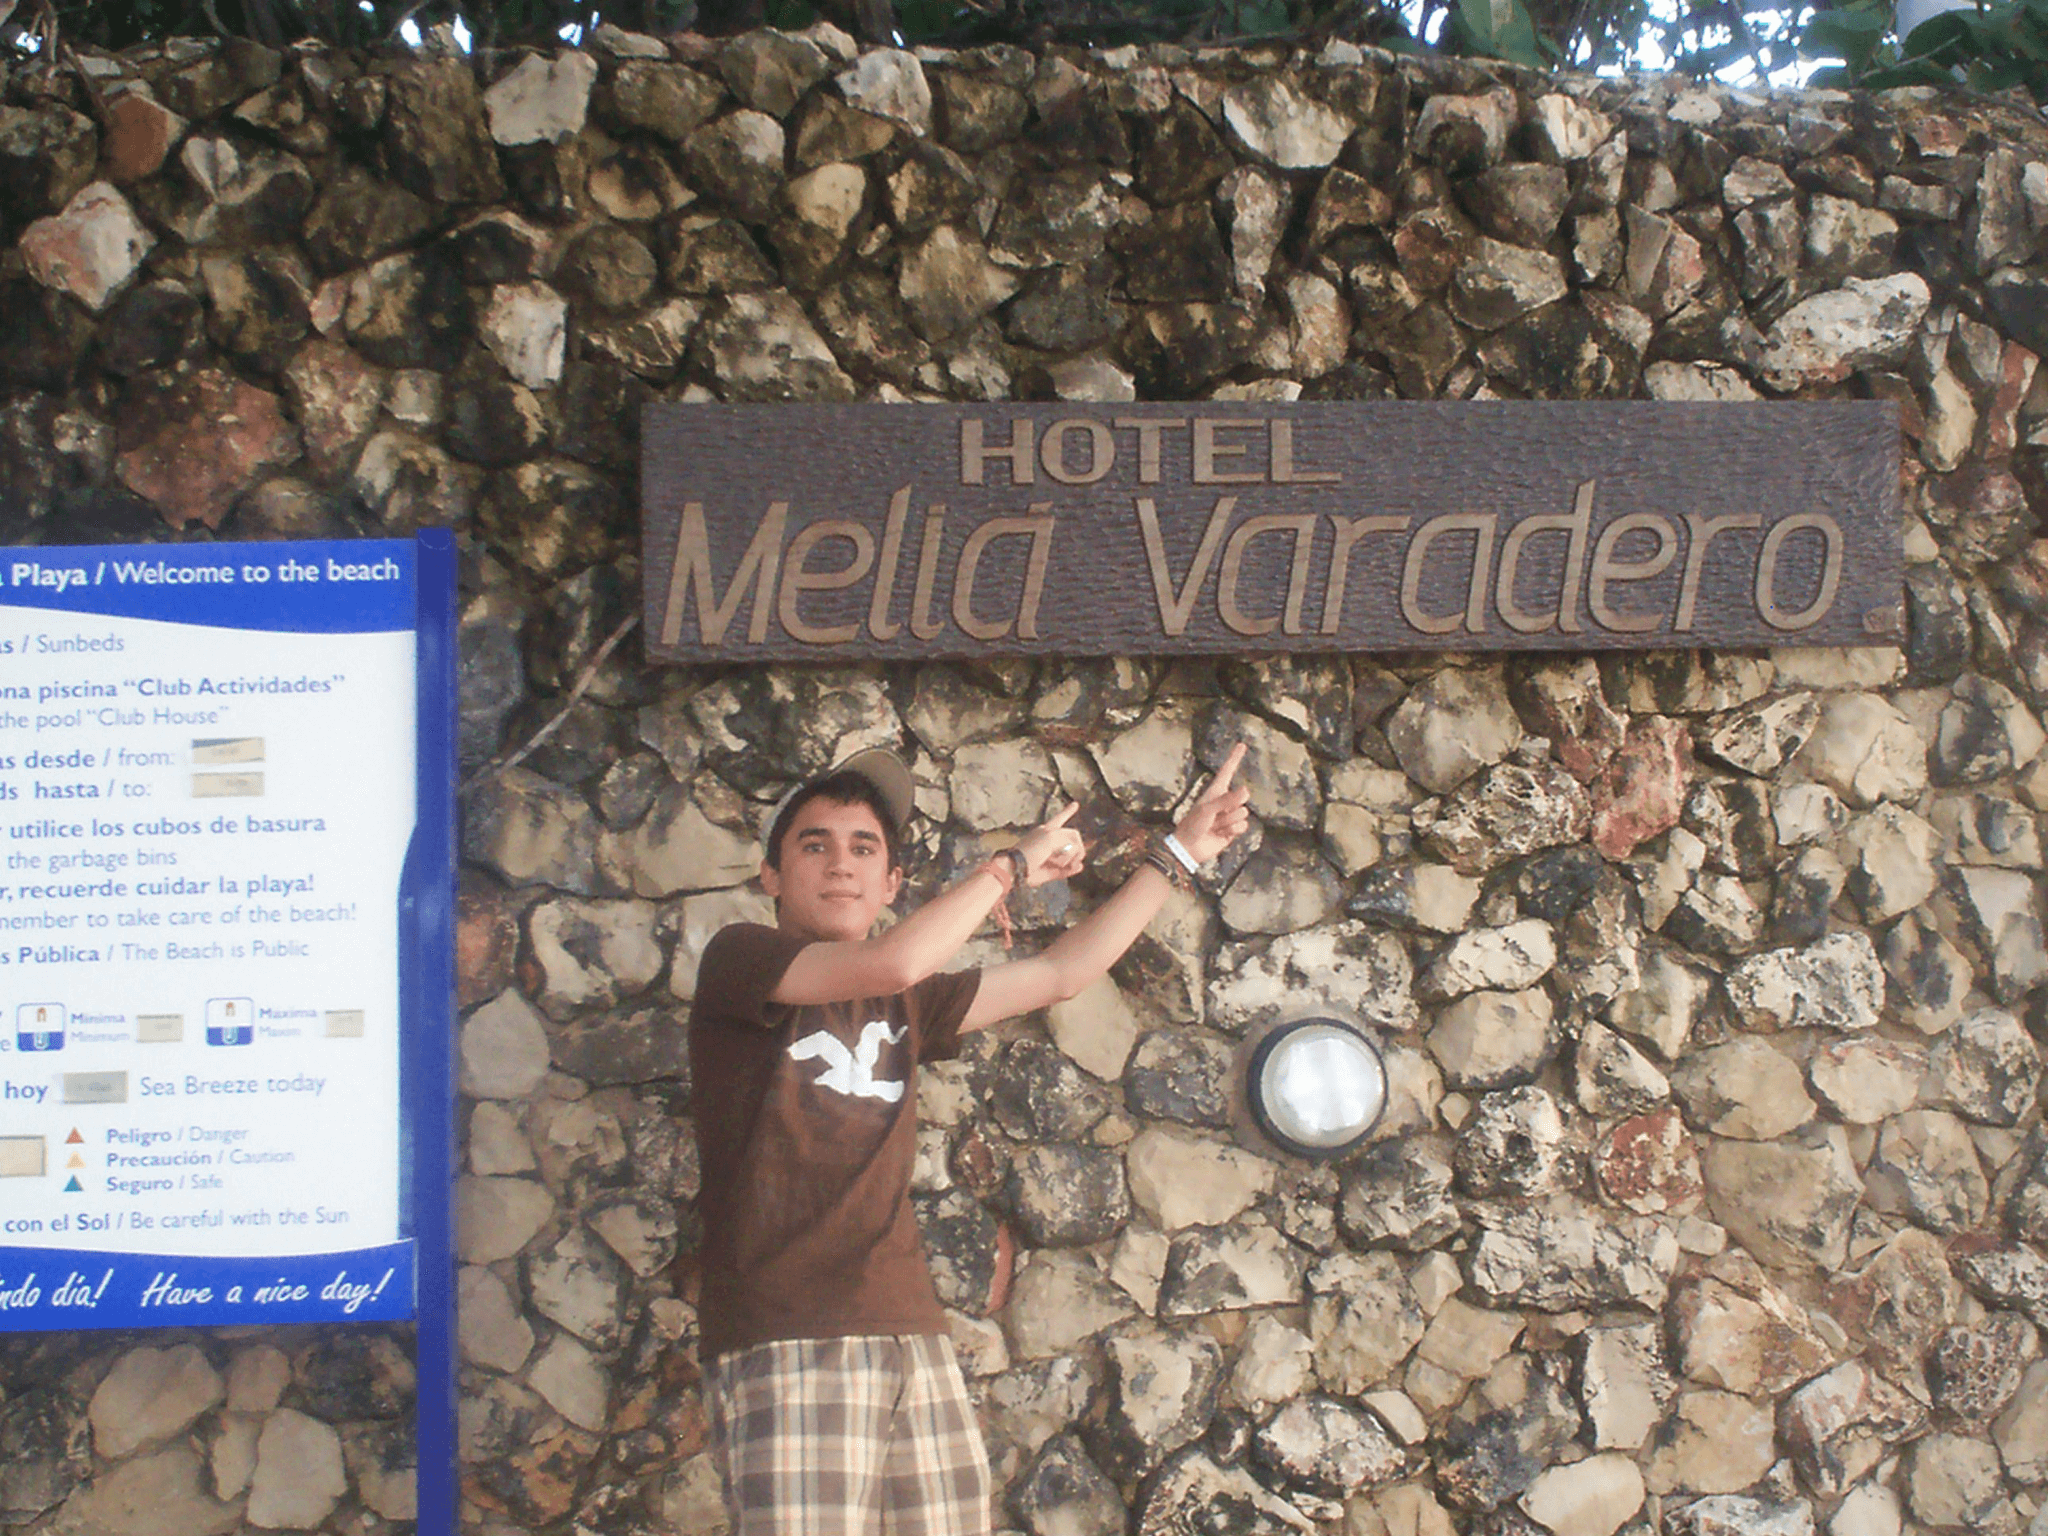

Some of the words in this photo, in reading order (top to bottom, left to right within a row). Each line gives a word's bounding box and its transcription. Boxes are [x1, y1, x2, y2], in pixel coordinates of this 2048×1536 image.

[960, 418, 1342, 485] HOTEL
[1136, 480, 1842, 638] Varadero
[12, 562, 89, 592] Playa
[113, 561, 235, 585] Welcome
[242, 564, 271, 582] to
[278, 560, 320, 583] the
[327, 557, 400, 581] beach
[36, 633, 125, 653] Sunbeds
[0, 686, 31, 699] na
[38, 680, 118, 704] piscina
[36, 708, 82, 733] pool
[24, 749, 96, 769] desde
[34, 780, 100, 799] hasta
[10, 820, 84, 839] utilice
[92, 818, 126, 837] los
[132, 817, 202, 836] cubos
[210, 815, 239, 835] de
[246, 814, 327, 833] basura
[8, 851, 41, 870] the
[48, 849, 129, 874] garbage
[136, 847, 178, 867] bins
[18, 878, 128, 899] recuerde
[135, 876, 211, 897] cuidar
[218, 875, 239, 895] la
[246, 873, 315, 899] playa!
[87, 914, 109, 928] to
[117, 908, 161, 928] take
[168, 910, 212, 927] care
[219, 904, 241, 925] of
[248, 904, 281, 924] the
[289, 902, 357, 923] beach!
[18, 944, 100, 964] Pública
[122, 942, 159, 962] The
[166, 940, 223, 961] Beach
[230, 941, 246, 959] is
[252, 938, 310, 959] Public
[5, 1080, 49, 1104] hoy
[139, 1077, 177, 1096] Sea
[185, 1075, 259, 1095] Breeze
[267, 1072, 327, 1097] today
[106, 1128, 173, 1148] Peligro
[189, 1125, 250, 1145] Danger
[106, 1150, 212, 1168] Precaución
[229, 1148, 296, 1165] Caution
[106, 1175, 174, 1196] Seguro
[190, 1173, 224, 1190] Safe
[5, 1219, 43, 1233] con
[50, 1213, 69, 1232] el
[76, 1212, 111, 1232] Sol
[130, 1211, 154, 1230] Be
[160, 1207, 224, 1229] careful
[231, 1207, 271, 1227] with
[278, 1207, 309, 1226] the
[315, 1206, 350, 1225] Sun
[140, 1271, 213, 1307] Have
[227, 1285, 242, 1303] a
[253, 1278, 310, 1304] nice
[320, 1267, 395, 1314] day!
